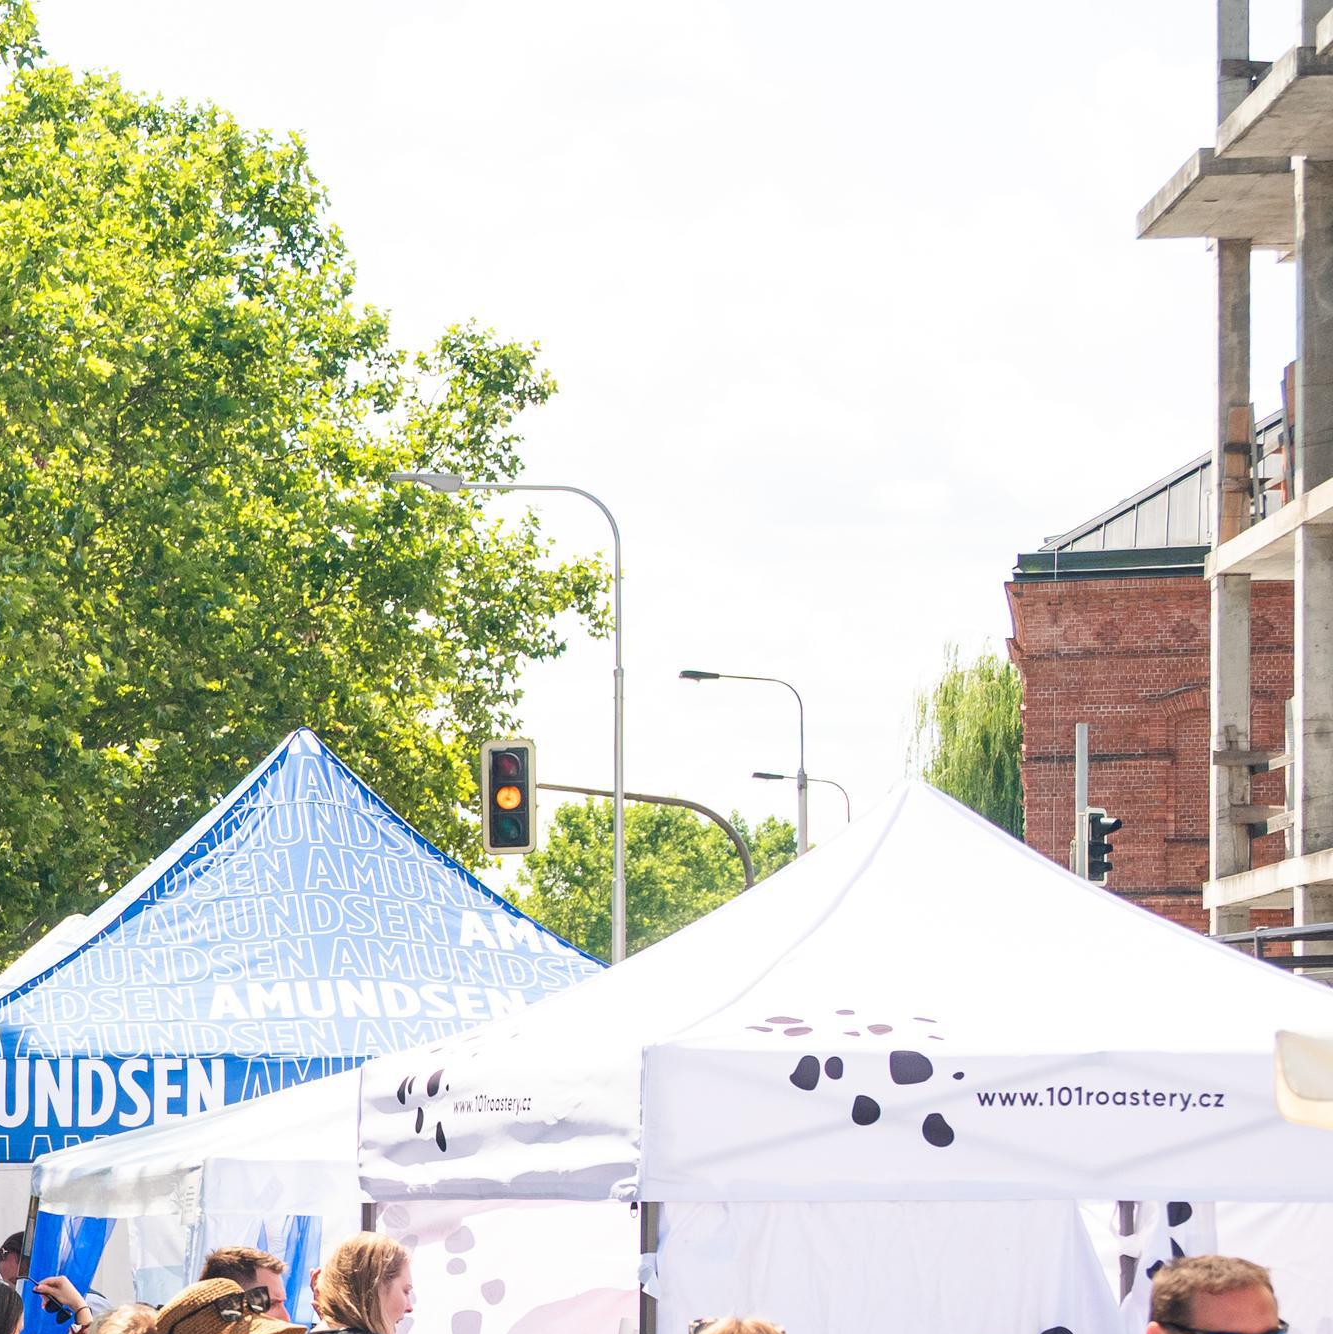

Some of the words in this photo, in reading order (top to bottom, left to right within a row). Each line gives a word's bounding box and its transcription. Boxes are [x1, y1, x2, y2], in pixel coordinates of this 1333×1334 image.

[135, 893, 450, 947] AMUNDSEN
[27, 938, 319, 990] MUNDSEN
[209, 981, 527, 1022] AMUNDSEN
[14, 1020, 344, 1060] AMUNDSEN
[453, 1094, 532, 1117] www.101roastery.cz
[977, 1086, 1225, 1112] www.101roastery.cz
